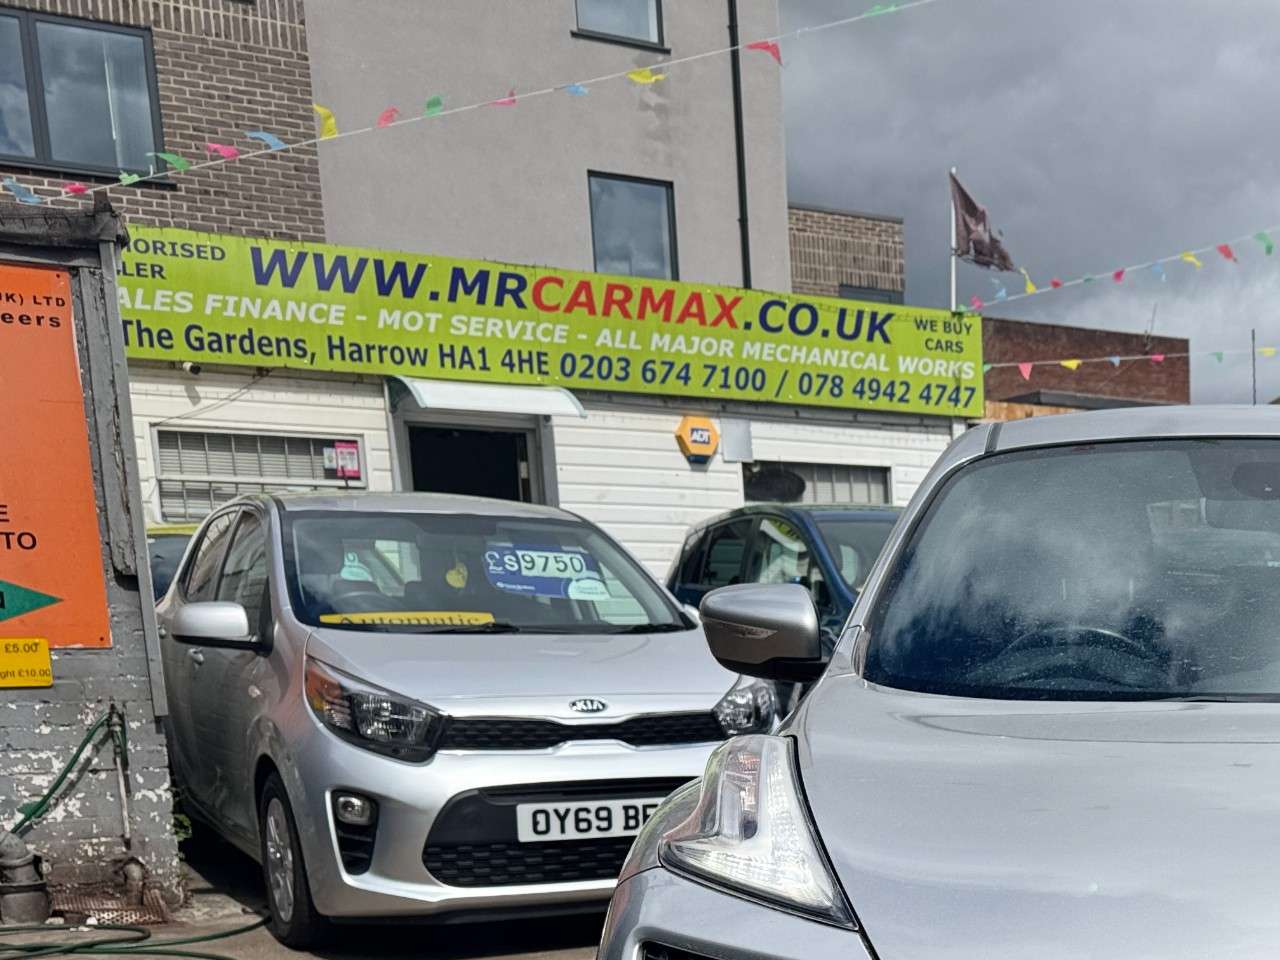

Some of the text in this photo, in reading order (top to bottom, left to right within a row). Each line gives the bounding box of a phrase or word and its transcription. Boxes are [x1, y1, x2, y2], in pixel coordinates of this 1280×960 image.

[117, 262, 166, 279] LER
[0, 292, 66, 307] K) LTD
[250, 246, 895, 344] WWW.MRCARMAX.CO.UK
[914, 316, 973, 336] WE BUY
[205, 294, 346, 325] FINANCE
[378, 309, 442, 333] MOT
[449, 315, 570, 344] SERVICE
[595, 328, 642, 350] ALL
[651, 333, 734, 358] MAJOR
[742, 341, 889, 372] MECHANICAL
[897, 356, 975, 380] WORKS
[925, 338, 963, 353] CARS
[122, 320, 174, 349] The
[184, 323, 316, 365] Gardens,
[327, 335, 428, 367] Harrow
[439, 344, 491, 371] HA1
[501, 349, 550, 376] 4HE
[559, 352, 631, 382] 0203
[641, 359, 692, 386] 674
[702, 364, 766, 392] 7100
[799, 373, 844, 398] 078
[852, 377, 911, 404] 4942
[919, 383, 976, 408] 4747
[691, 430, 710, 443] ADT
[572, 699, 603, 713] KIA
[532, 806, 613, 836] OY69
